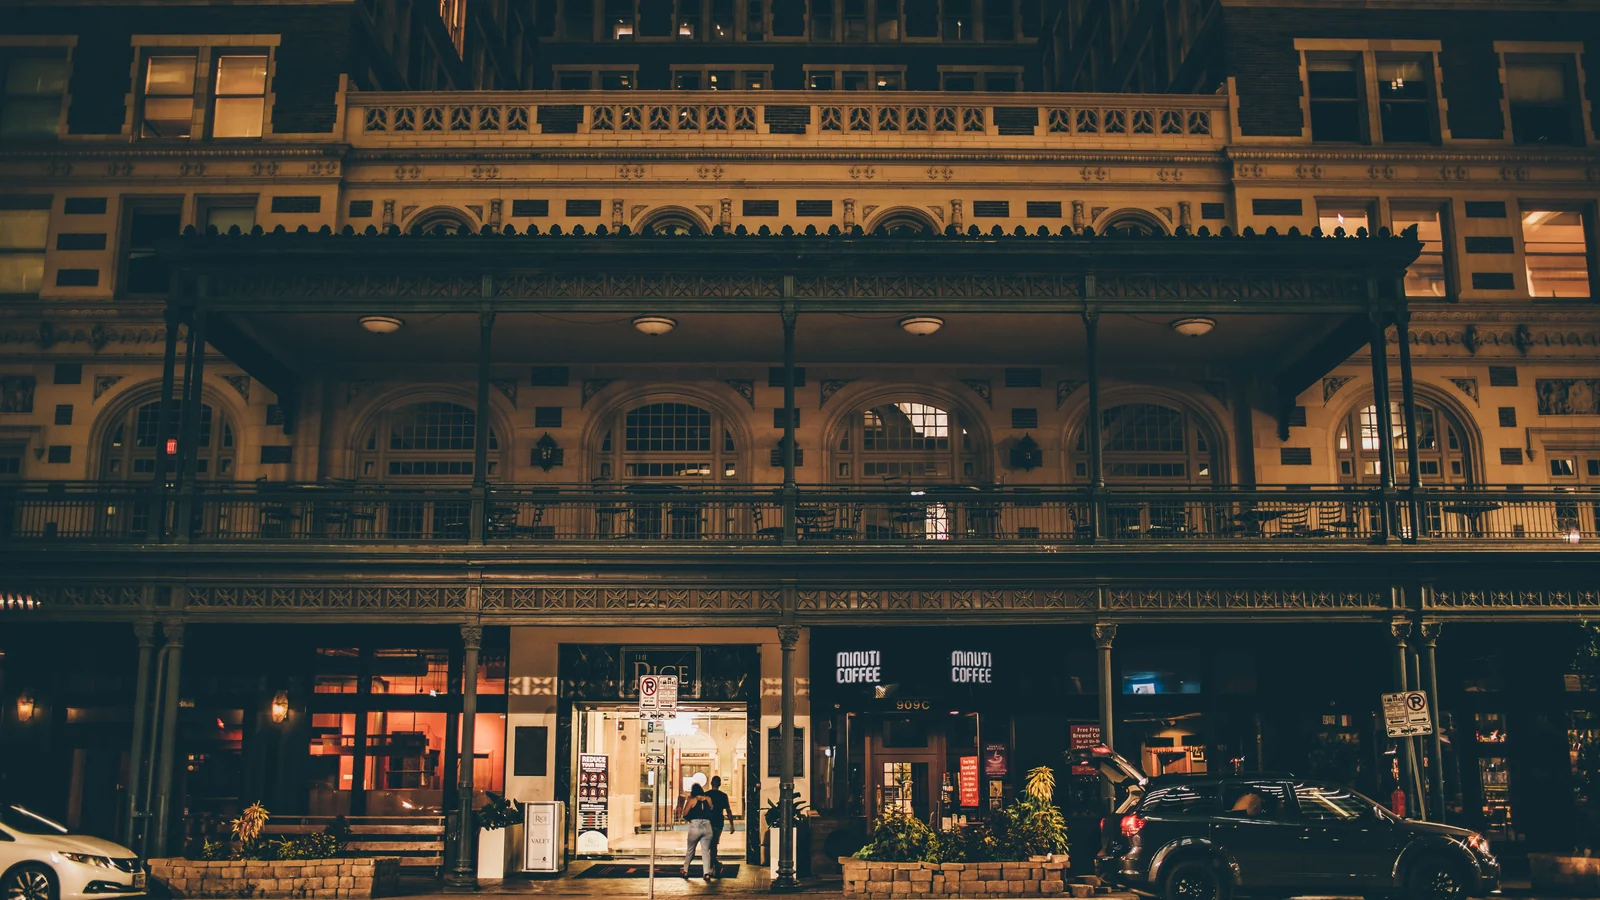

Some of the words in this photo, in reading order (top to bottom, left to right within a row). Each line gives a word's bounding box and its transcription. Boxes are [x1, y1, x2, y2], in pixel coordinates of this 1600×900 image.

[836, 650, 880, 667] MINUTI
[951, 650, 992, 667] MINUTI
[836, 667, 881, 683] COFFEE
[951, 667, 992, 683] COFFEE
[896, 700, 930, 710] 909C
